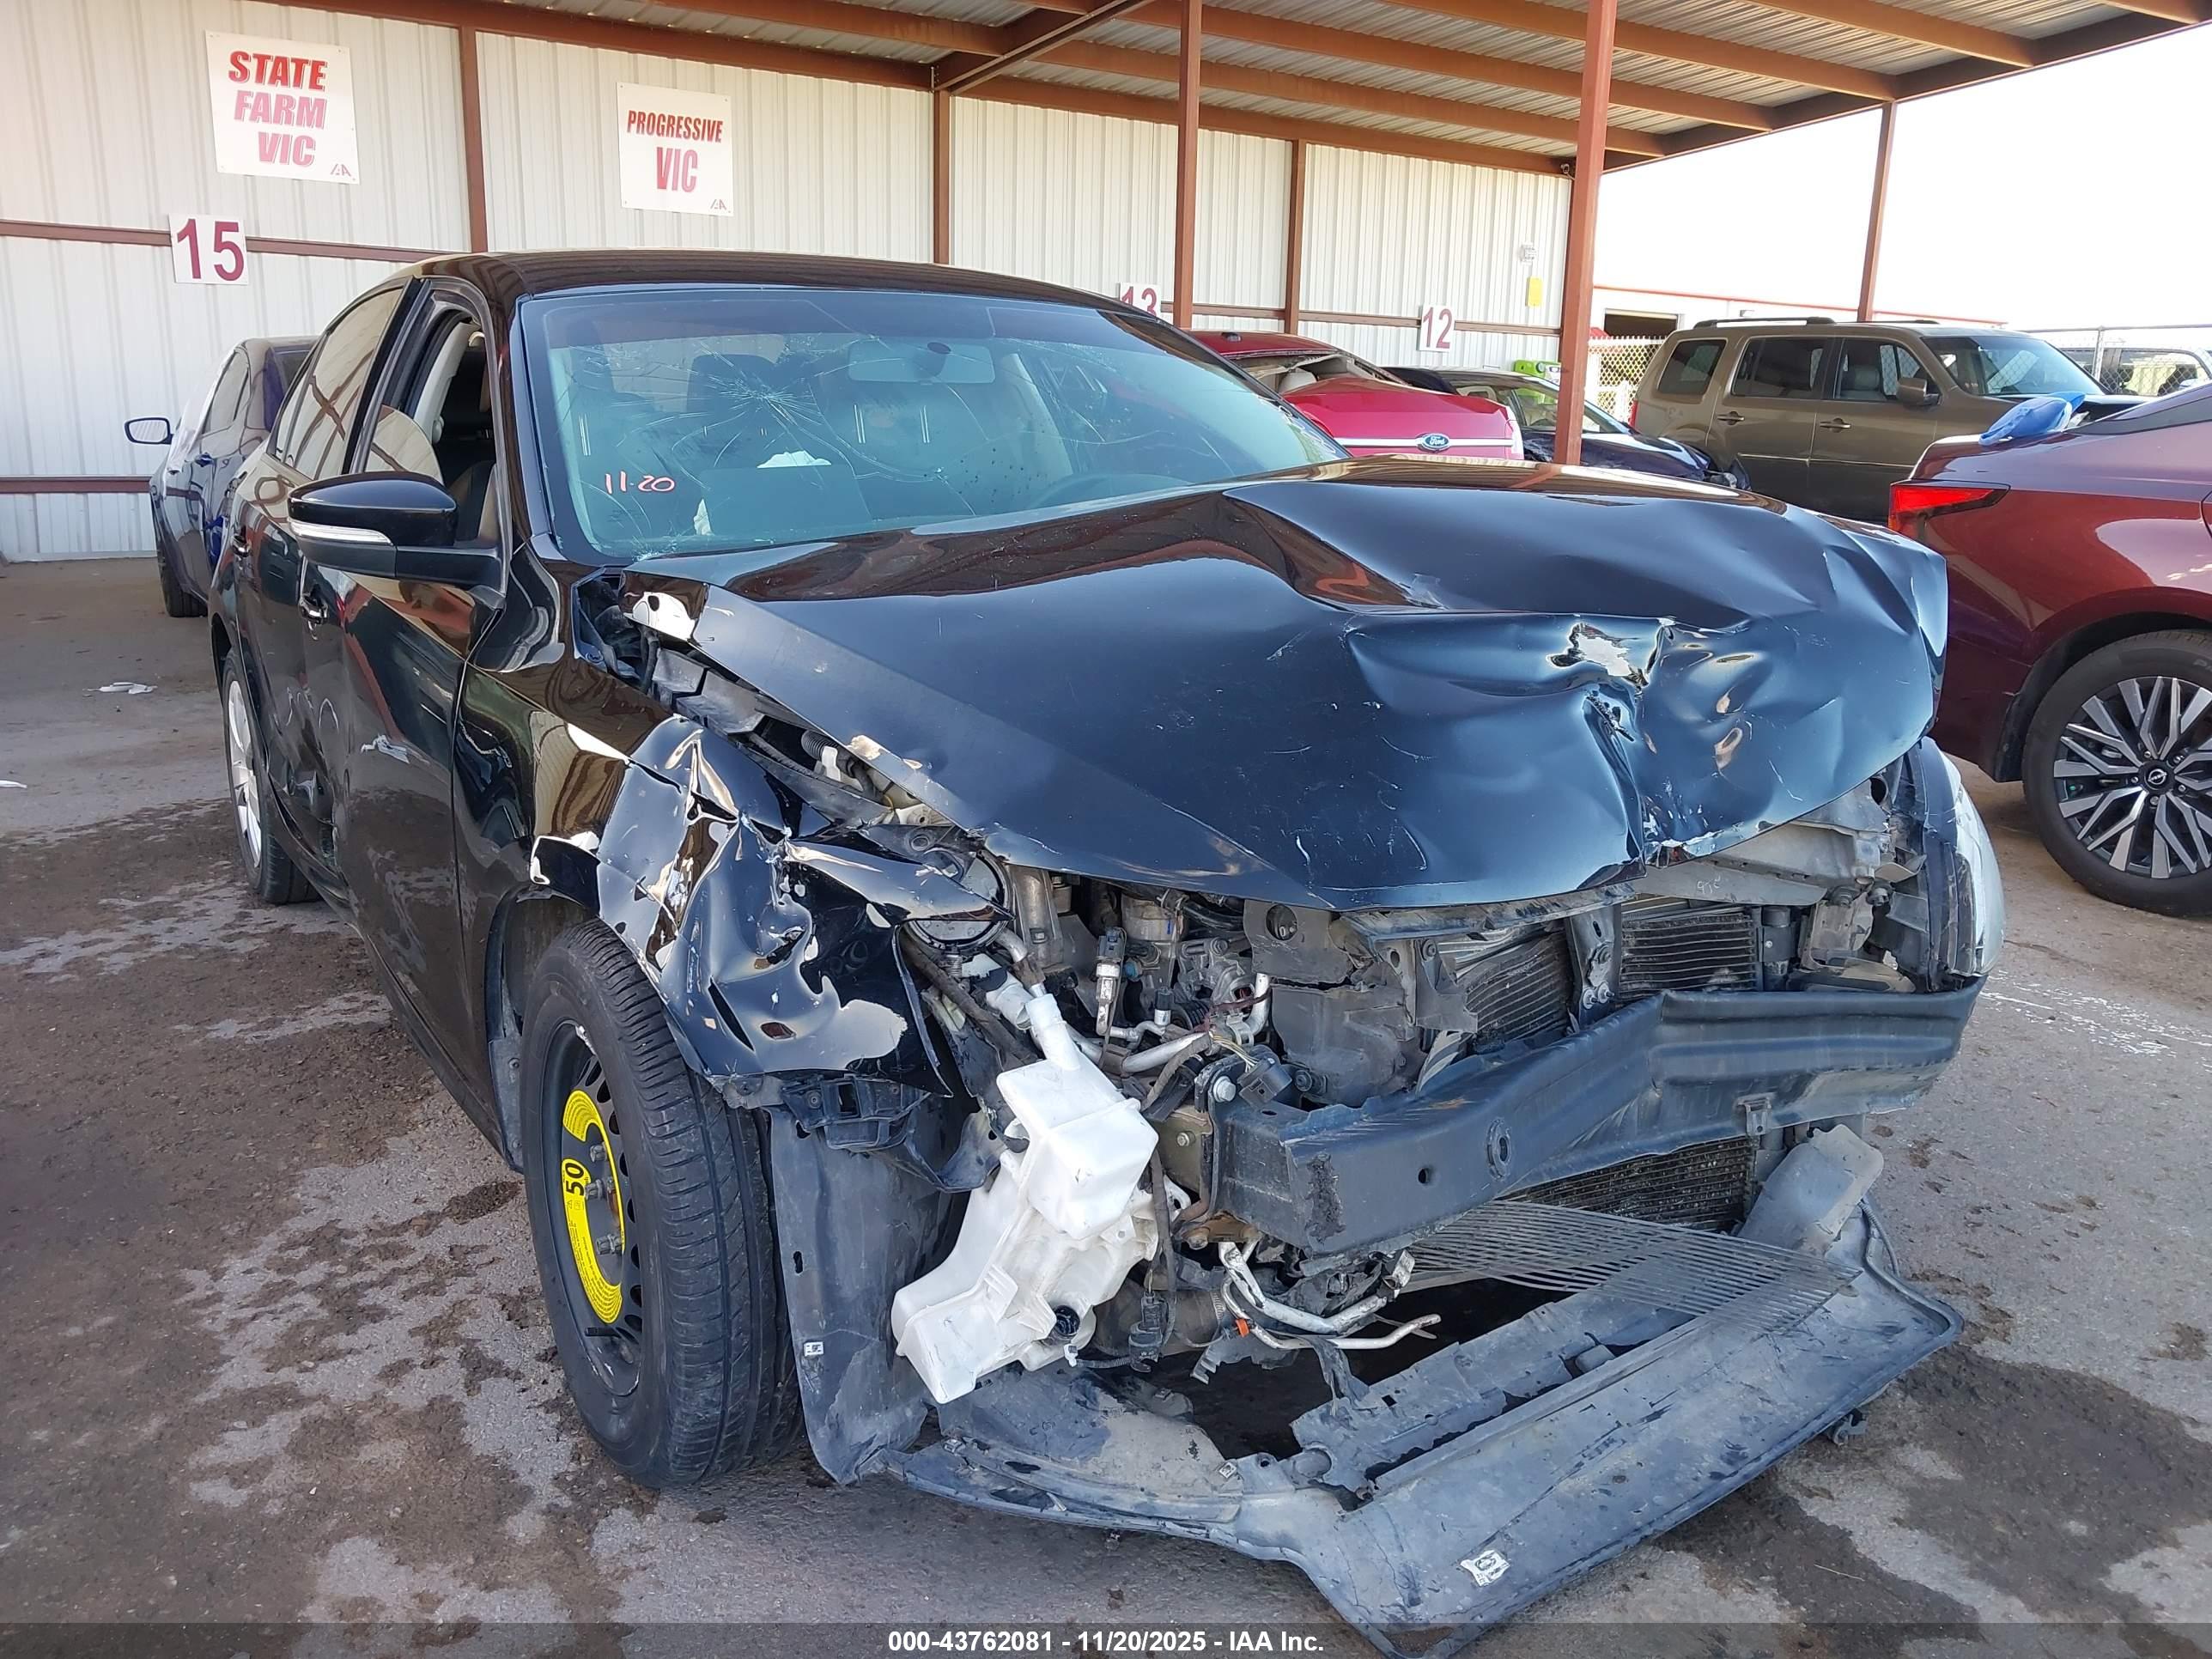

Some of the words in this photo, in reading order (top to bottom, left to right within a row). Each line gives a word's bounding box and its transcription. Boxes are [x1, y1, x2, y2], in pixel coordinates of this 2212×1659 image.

[228, 51, 328, 92] STATE
[234, 89, 328, 130] FARM
[627, 110, 723, 143] PROGRESSIVE
[258, 131, 316, 167] VIC
[656, 146, 698, 193] VIC
[176, 218, 245, 282] 15
[1422, 307, 1453, 349] 12
[1429, 435, 1446, 446] Ford
[565, 1162, 585, 1196] 50
